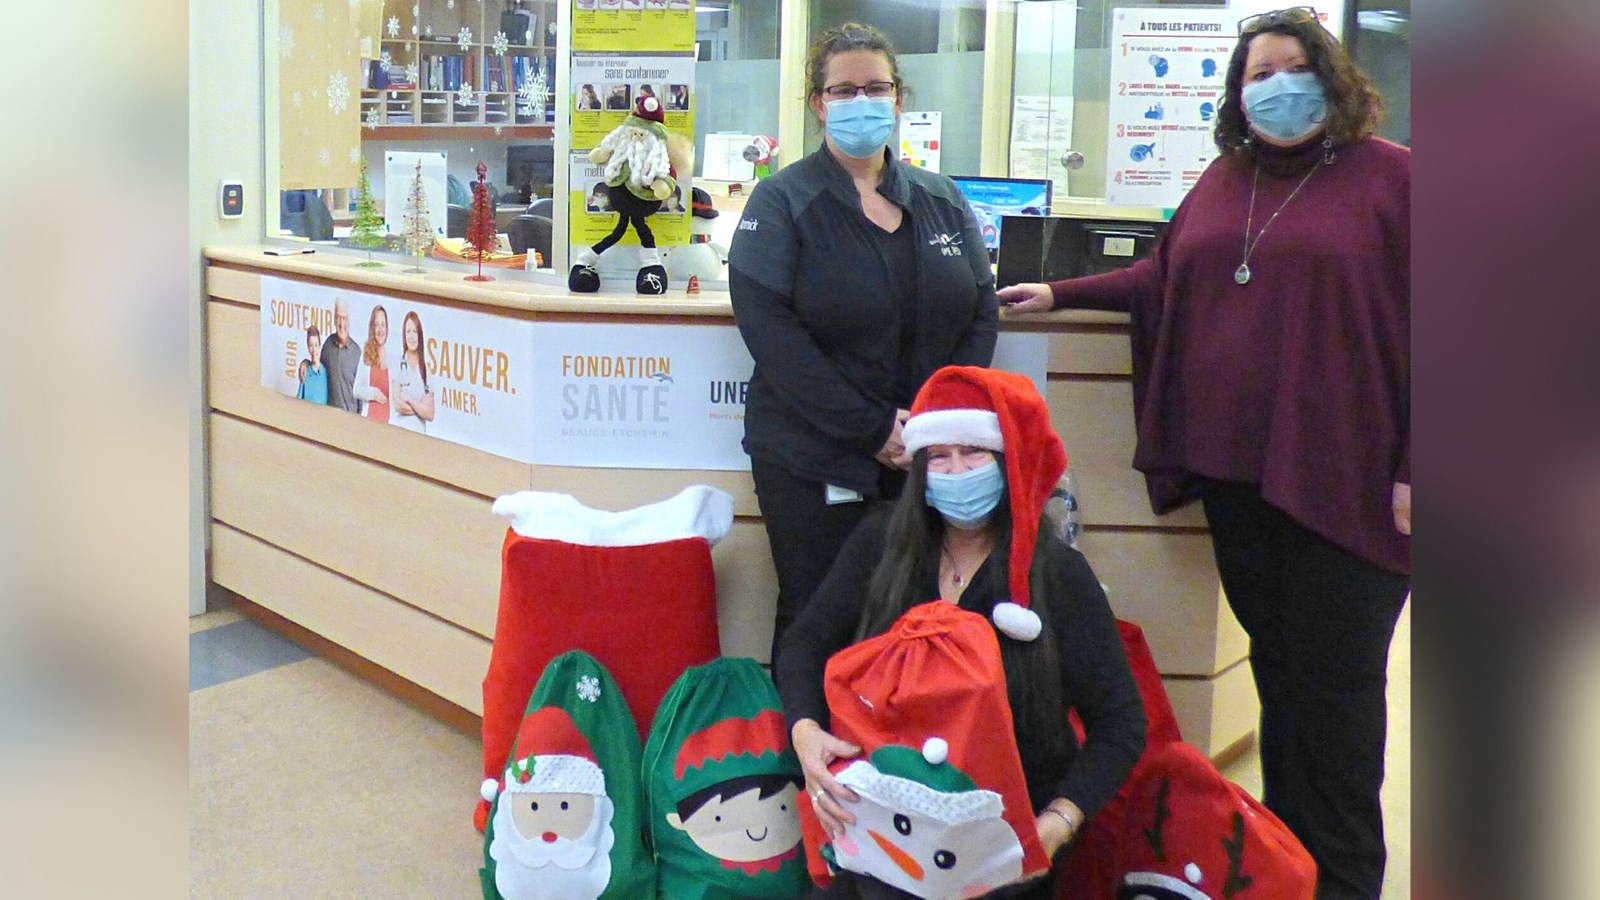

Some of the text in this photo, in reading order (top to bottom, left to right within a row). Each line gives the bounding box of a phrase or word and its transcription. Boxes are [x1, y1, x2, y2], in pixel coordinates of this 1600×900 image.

[1147, 22, 1167, 31] TOUS
[1169, 23, 1181, 31] LES
[1121, 42, 1127, 56] 1
[605, 66, 669, 79] sans contaminer
[1119, 82, 1126, 96] 2
[1117, 123, 1125, 138] 3
[1114, 170, 1122, 185] 4
[270, 299, 333, 337] SOUTENIR
[285, 336, 298, 379] AGIR.
[426, 337, 516, 395] SAUVER.
[562, 355, 671, 379] FONDATION
[441, 386, 481, 416] AIMER.
